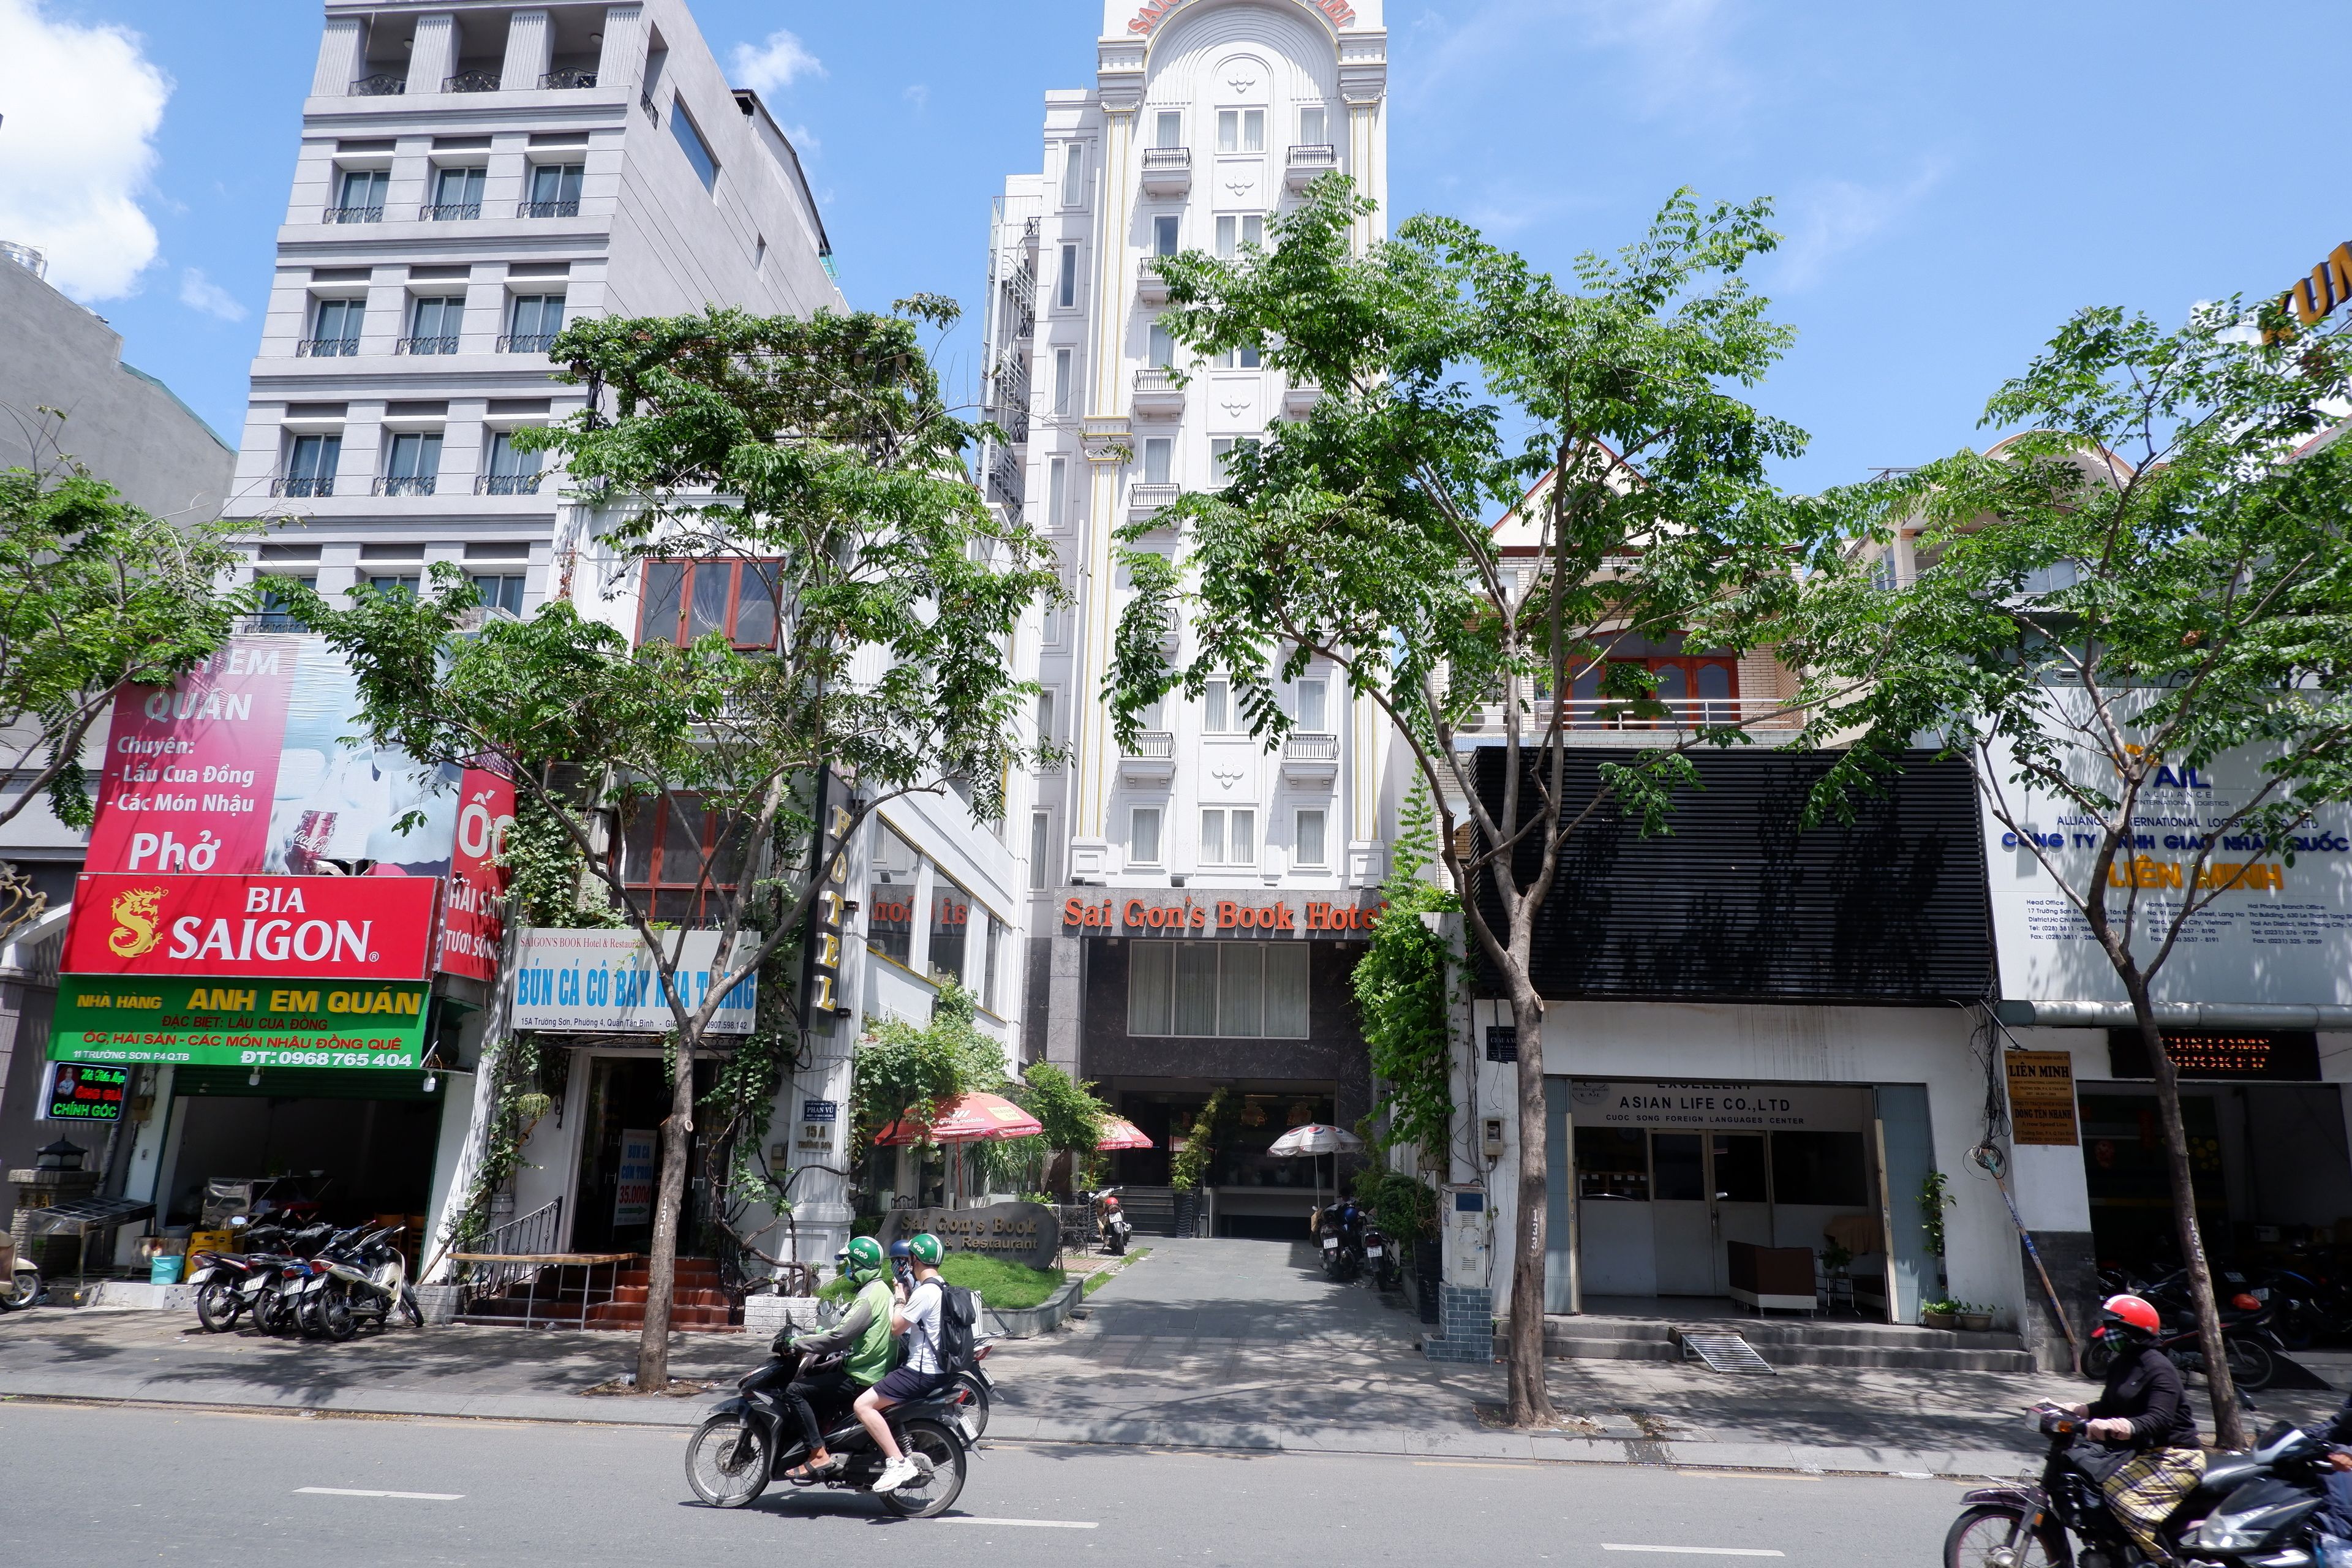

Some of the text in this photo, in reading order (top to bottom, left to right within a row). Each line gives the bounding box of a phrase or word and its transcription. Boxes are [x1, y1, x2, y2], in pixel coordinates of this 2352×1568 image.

[227, 649, 279, 675] EM
[145, 687, 252, 723] QUÁN
[118, 736, 195, 758] Chuyên:
[123, 763, 255, 787] Lẩu Cua Đồng
[2153, 766, 2211, 788] AIL
[118, 793, 254, 816] Các Món Nhậu
[129, 830, 221, 871] Phở
[2073, 834, 2096, 848] TY
[246, 888, 306, 913] BIA
[816, 804, 851, 1012] HOTEL
[1064, 898, 1113, 927] Sai
[1123, 896, 1205, 928] Gon's
[1216, 901, 1294, 930] Book
[169, 916, 372, 962] SAIGON
[446, 929, 470, 955] TƯƠI
[521, 937, 646, 948] SAIGON'S BOOK Hotel & Restaurant
[517, 958, 554, 1006] BÚN
[559, 959, 580, 1006] CÁ
[586, 959, 609, 1007] CÔ
[614, 956, 650, 1008] BẢY
[77, 986, 421, 1014] NHÀ HÀNG ANH EM QUÁN
[258, 1018, 284, 1030] CUA
[535, 1017, 556, 1027] Trường
[575, 1018, 598, 1027] Phường
[608, 1019, 624, 1027] Quận
[187, 1033, 221, 1047] CÁC
[226, 1034, 262, 1048] MÓN
[266, 1036, 311, 1050] NHẬU
[315, 1034, 363, 1049] ĐỒNG
[368, 1037, 402, 1050] QUÊ
[84, 1050, 126, 1060] TRƯỜNG
[128, 1052, 151, 1060] SƠN
[279, 1051, 329, 1066] 0968
[332, 1054, 369, 1066] 765
[372, 1054, 412, 1067] 404
[2009, 1061, 2070, 1078] LIÊN MINH
[53, 1101, 89, 1116] CHÍNH
[1619, 1096, 1671, 1109] ASIAN
[1681, 1097, 1714, 1110] LIFE
[2048, 1109, 2072, 1119] NHANH
[805, 1125, 817, 1138] 15
[902, 1215, 928, 1231] Sai
[993, 1216, 1037, 1234] Book
[913, 1242, 925, 1254] Grab
[962, 1235, 1038, 1250] Restaurant
[854, 1248, 869, 1259] Grab
